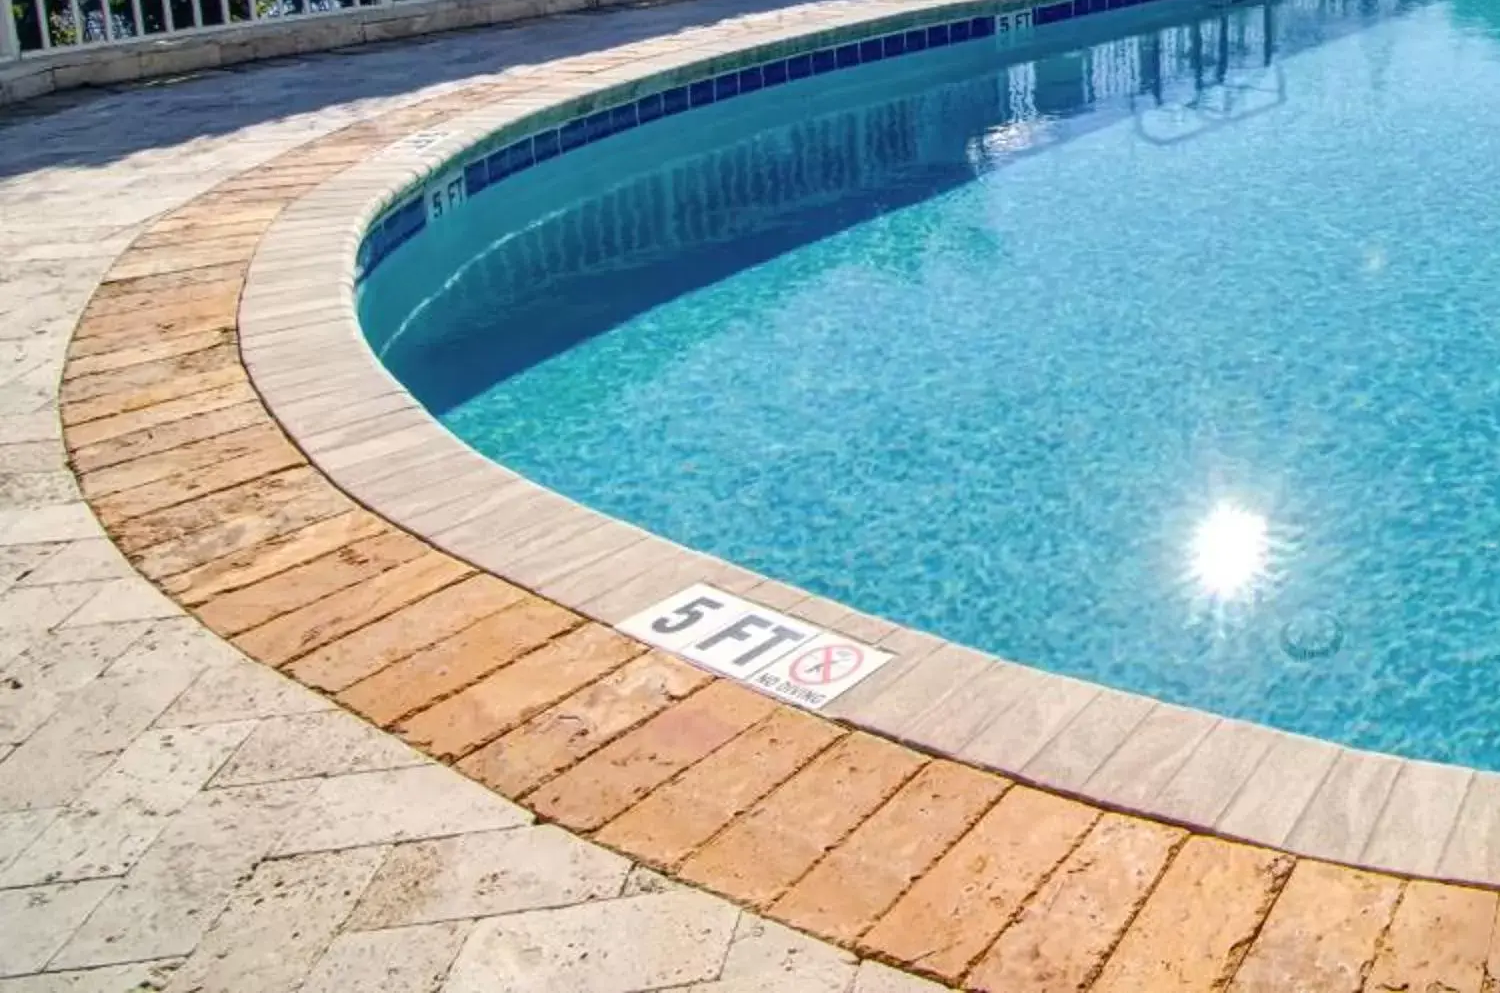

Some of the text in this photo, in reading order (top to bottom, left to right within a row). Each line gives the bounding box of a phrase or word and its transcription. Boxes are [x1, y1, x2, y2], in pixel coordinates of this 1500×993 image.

[1015, 12, 1031, 30] FT
[432, 176, 463, 218] 5 FT
[651, 596, 805, 666] 5 FT
[756, 672, 827, 704] NO DIVING
